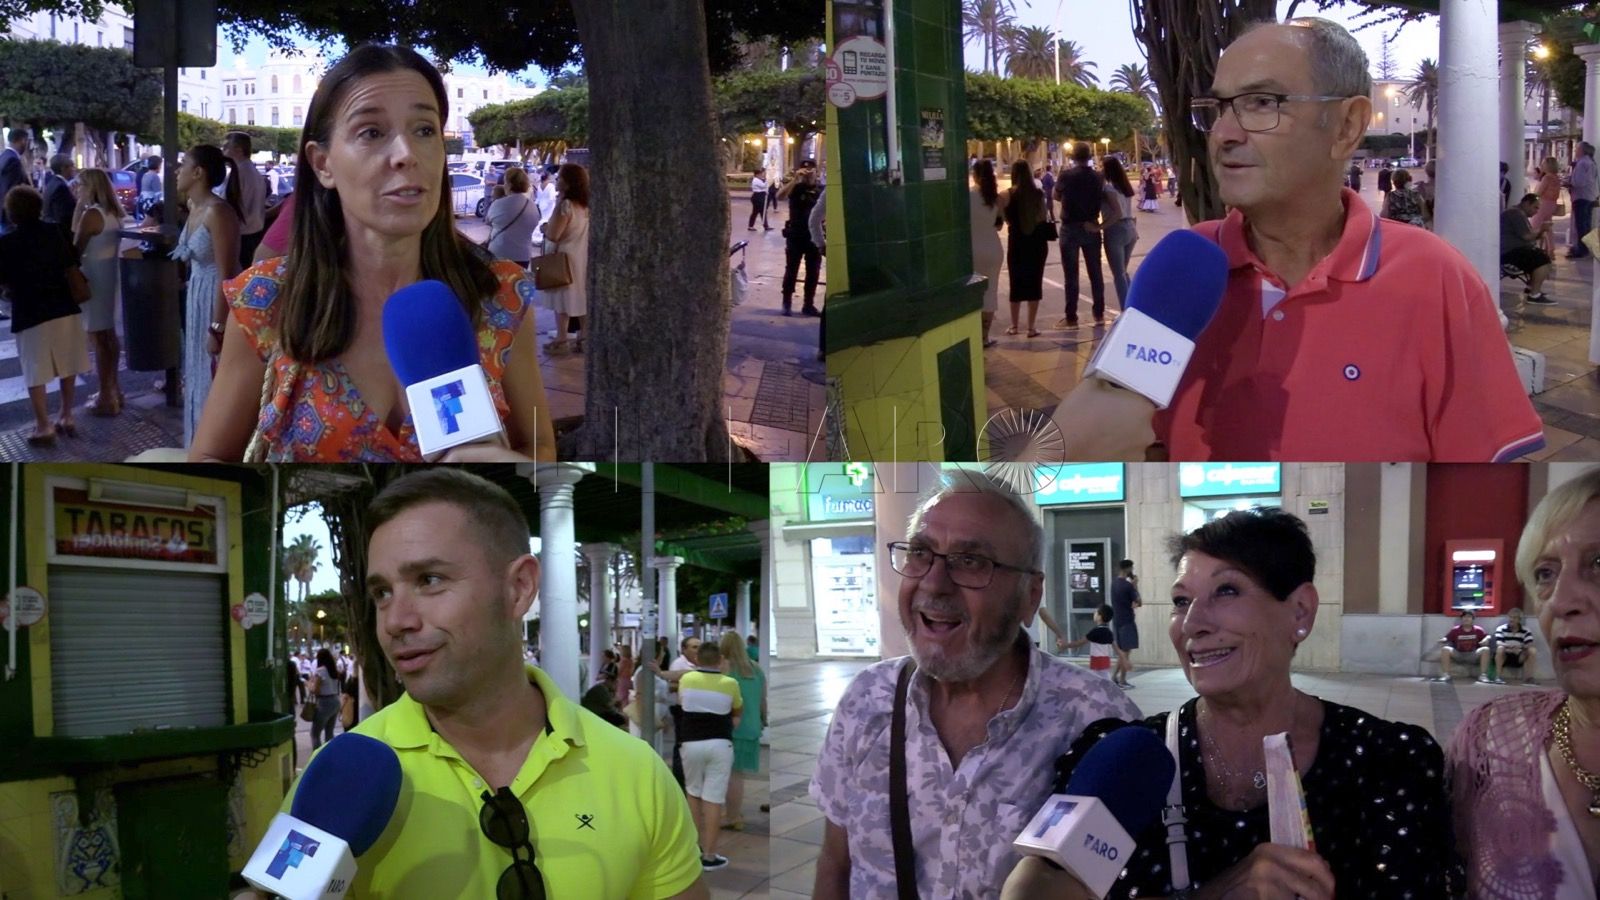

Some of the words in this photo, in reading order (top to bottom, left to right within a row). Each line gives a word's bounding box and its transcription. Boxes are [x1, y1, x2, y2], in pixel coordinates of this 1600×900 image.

[1126, 343, 1172, 365] FARO
[64, 507, 204, 546] TABACOS
[1083, 833, 1119, 861] FARO
